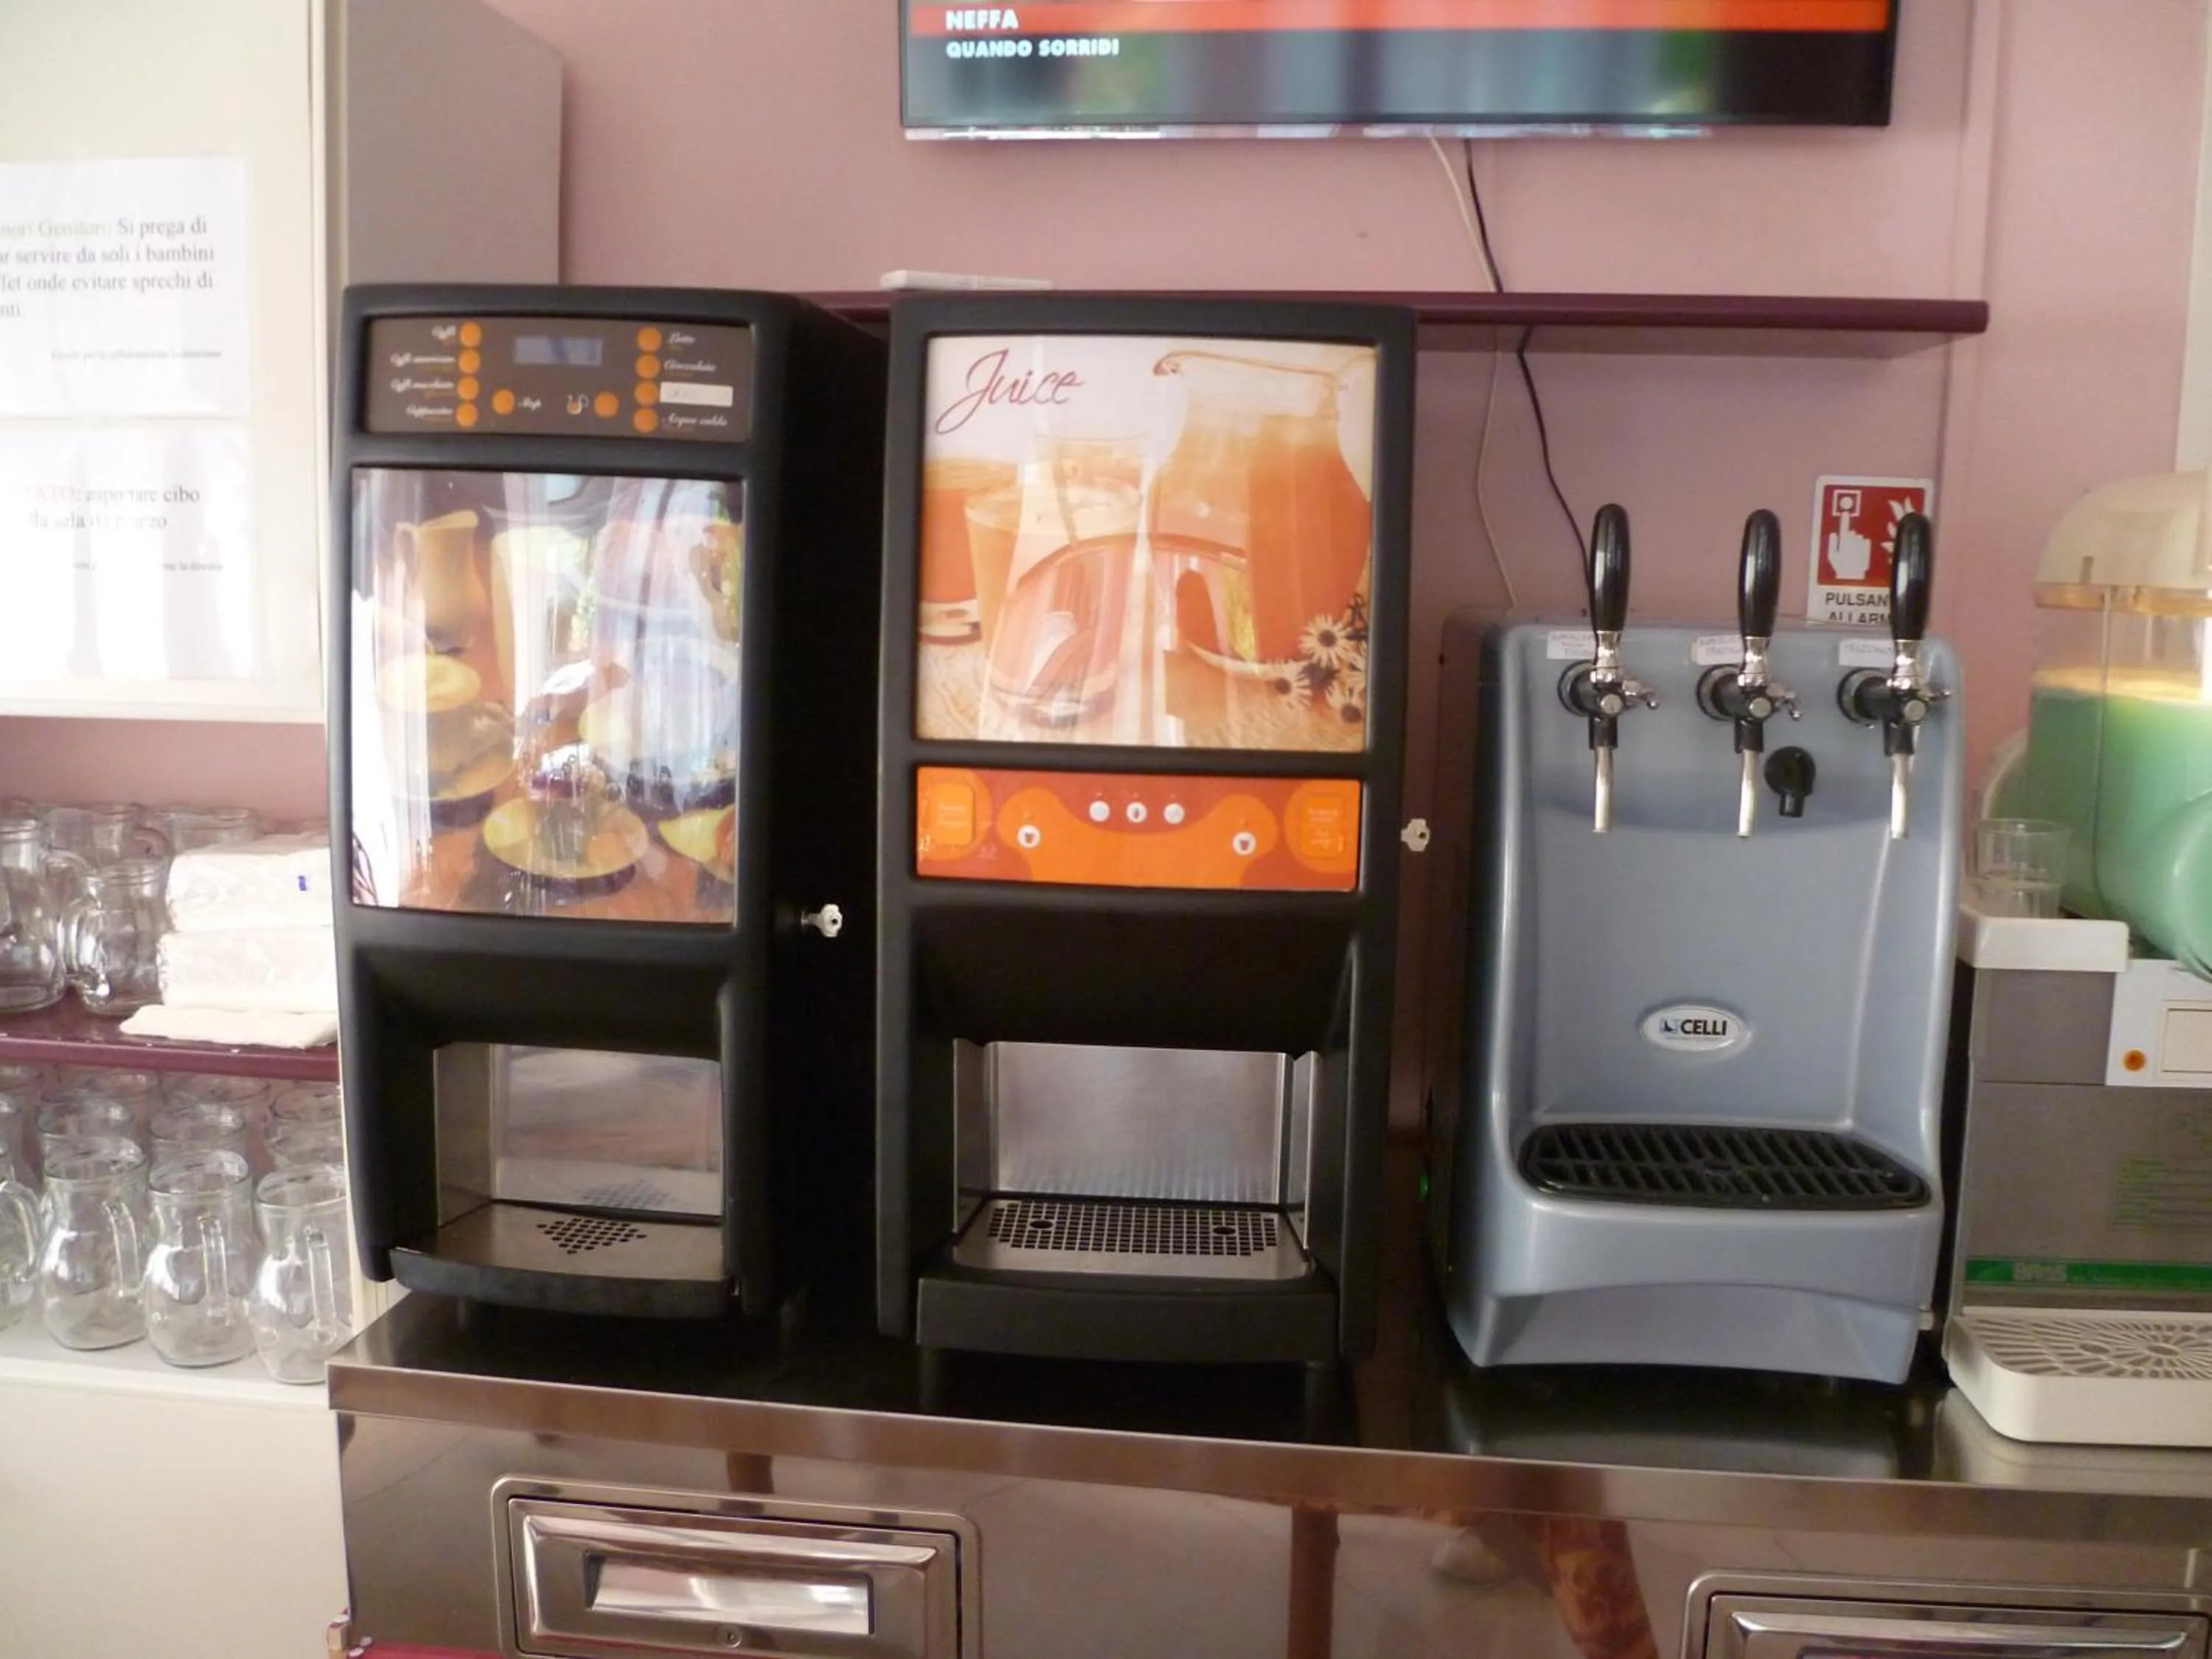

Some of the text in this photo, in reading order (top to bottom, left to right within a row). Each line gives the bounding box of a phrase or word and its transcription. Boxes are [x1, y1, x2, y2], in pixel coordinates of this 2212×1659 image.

[945, 10, 1019, 29] NEFFA
[946, 38, 1120, 58] QUANDO SORRIDI
[116, 217, 134, 234] Si
[139, 220, 185, 240] prega
[190, 215, 207, 235] di
[15, 250, 72, 264] servire
[76, 245, 97, 264] da
[101, 243, 130, 262] soli
[147, 243, 215, 262] bambini
[27, 272, 66, 291] onde
[72, 274, 128, 291] evitare
[133, 270, 191, 293] sprechi
[197, 269, 213, 289] di
[934, 348, 1086, 435] Juice
[163, 484, 201, 503] cibo
[1825, 592, 1889, 607] PULSAN
[1829, 611, 1892, 625] ALLARM
[1680, 1018, 1728, 1036] CELLI
